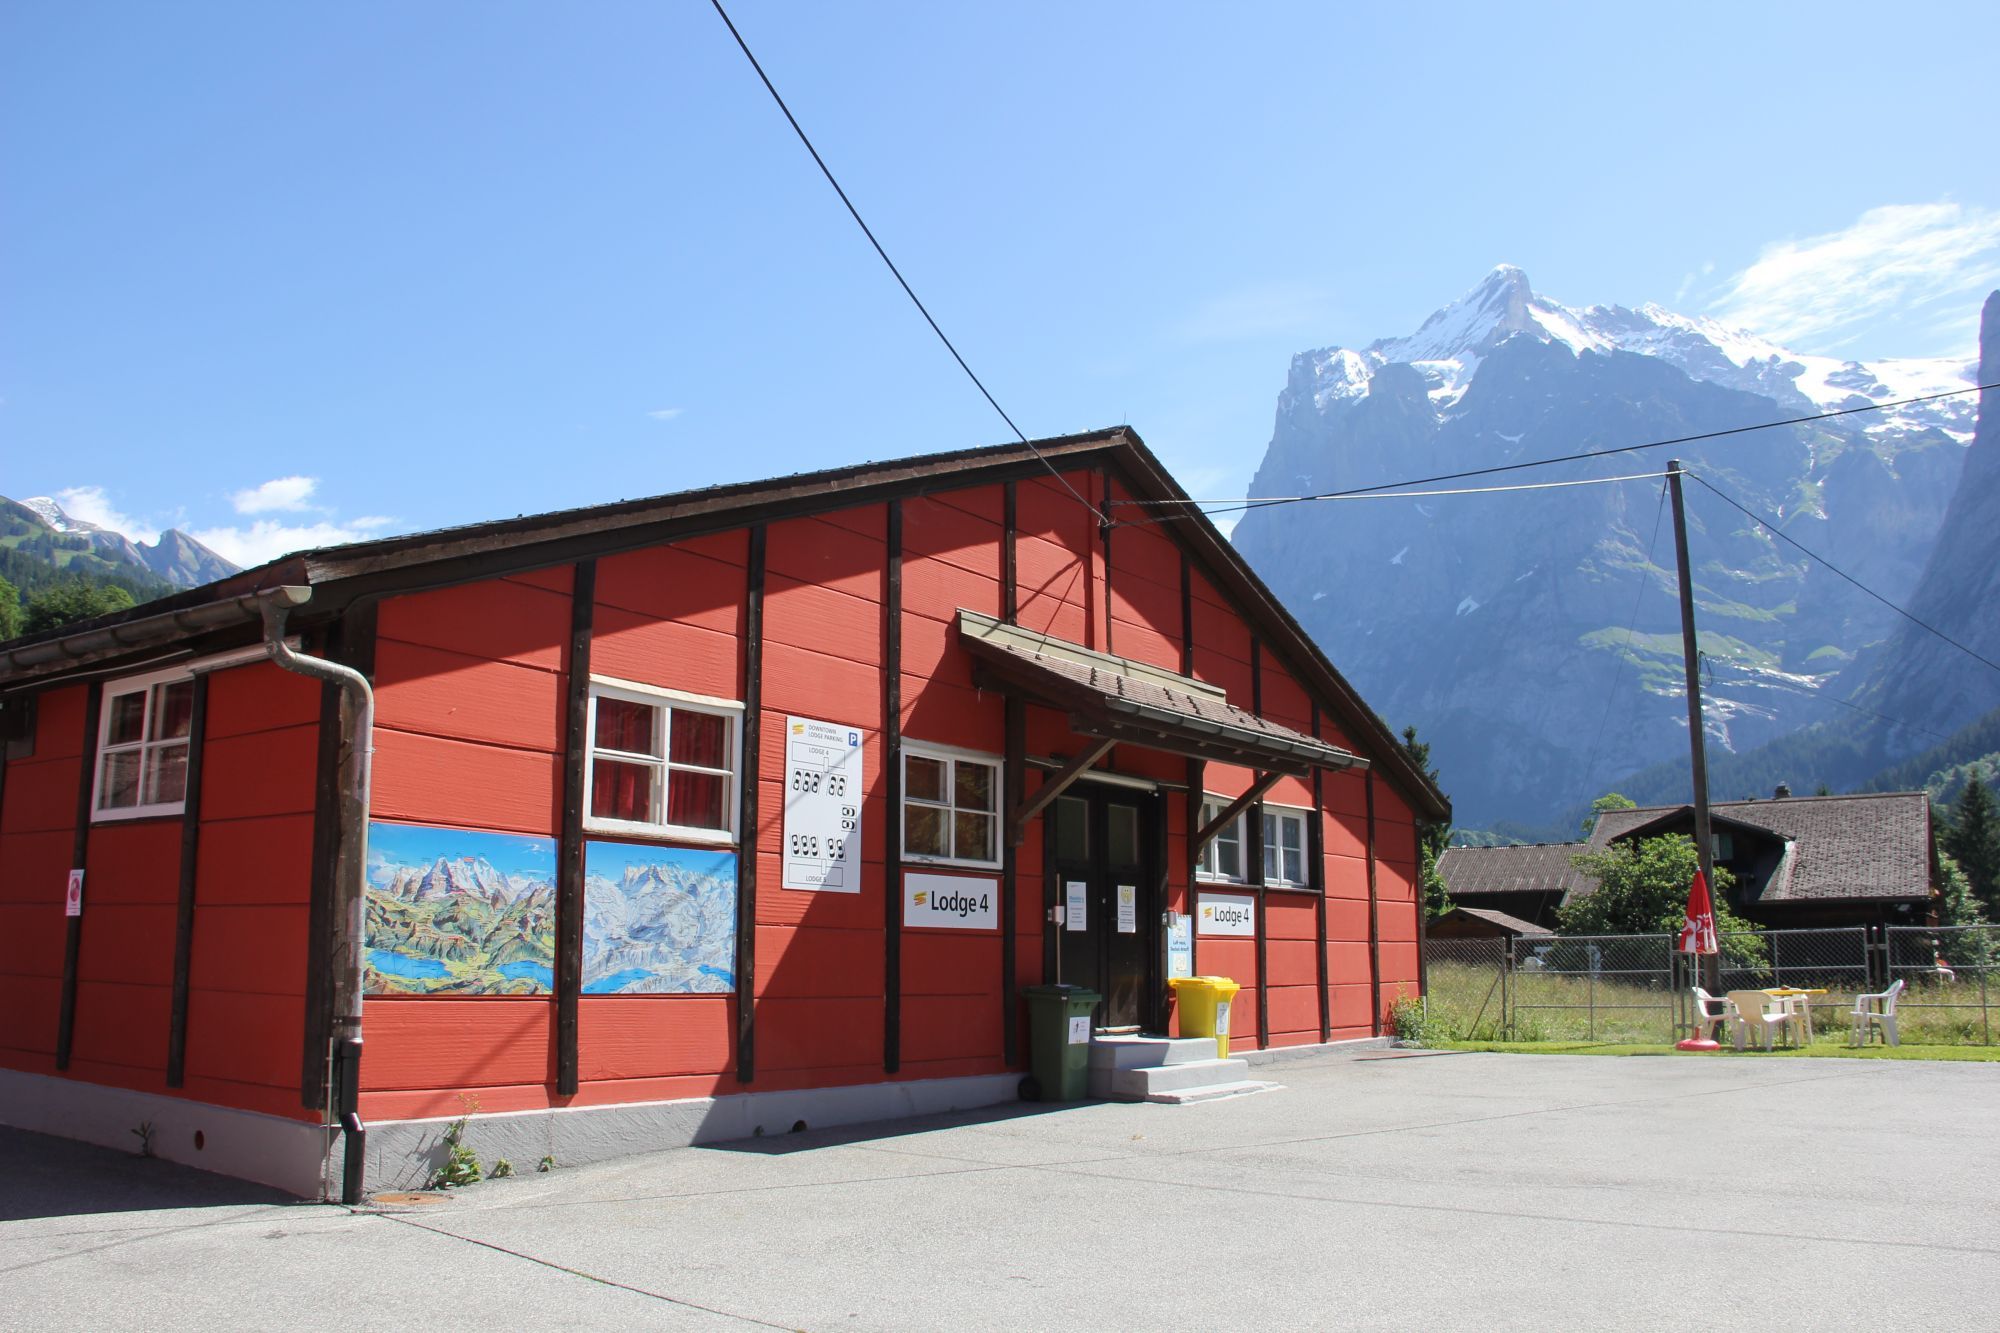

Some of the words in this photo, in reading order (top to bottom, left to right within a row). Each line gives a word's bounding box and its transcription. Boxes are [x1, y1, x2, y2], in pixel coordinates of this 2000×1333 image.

[808, 724, 836, 734] DOWNTOWN
[824, 734, 843, 742] PARKING
[808, 747, 824, 755] LODGE
[805, 875, 822, 883] LODGE
[931, 890, 977, 917] Lodge
[979, 893, 989, 912] 4
[1214, 906, 1242, 926] Lodge
[1244, 908, 1249, 923] 4
